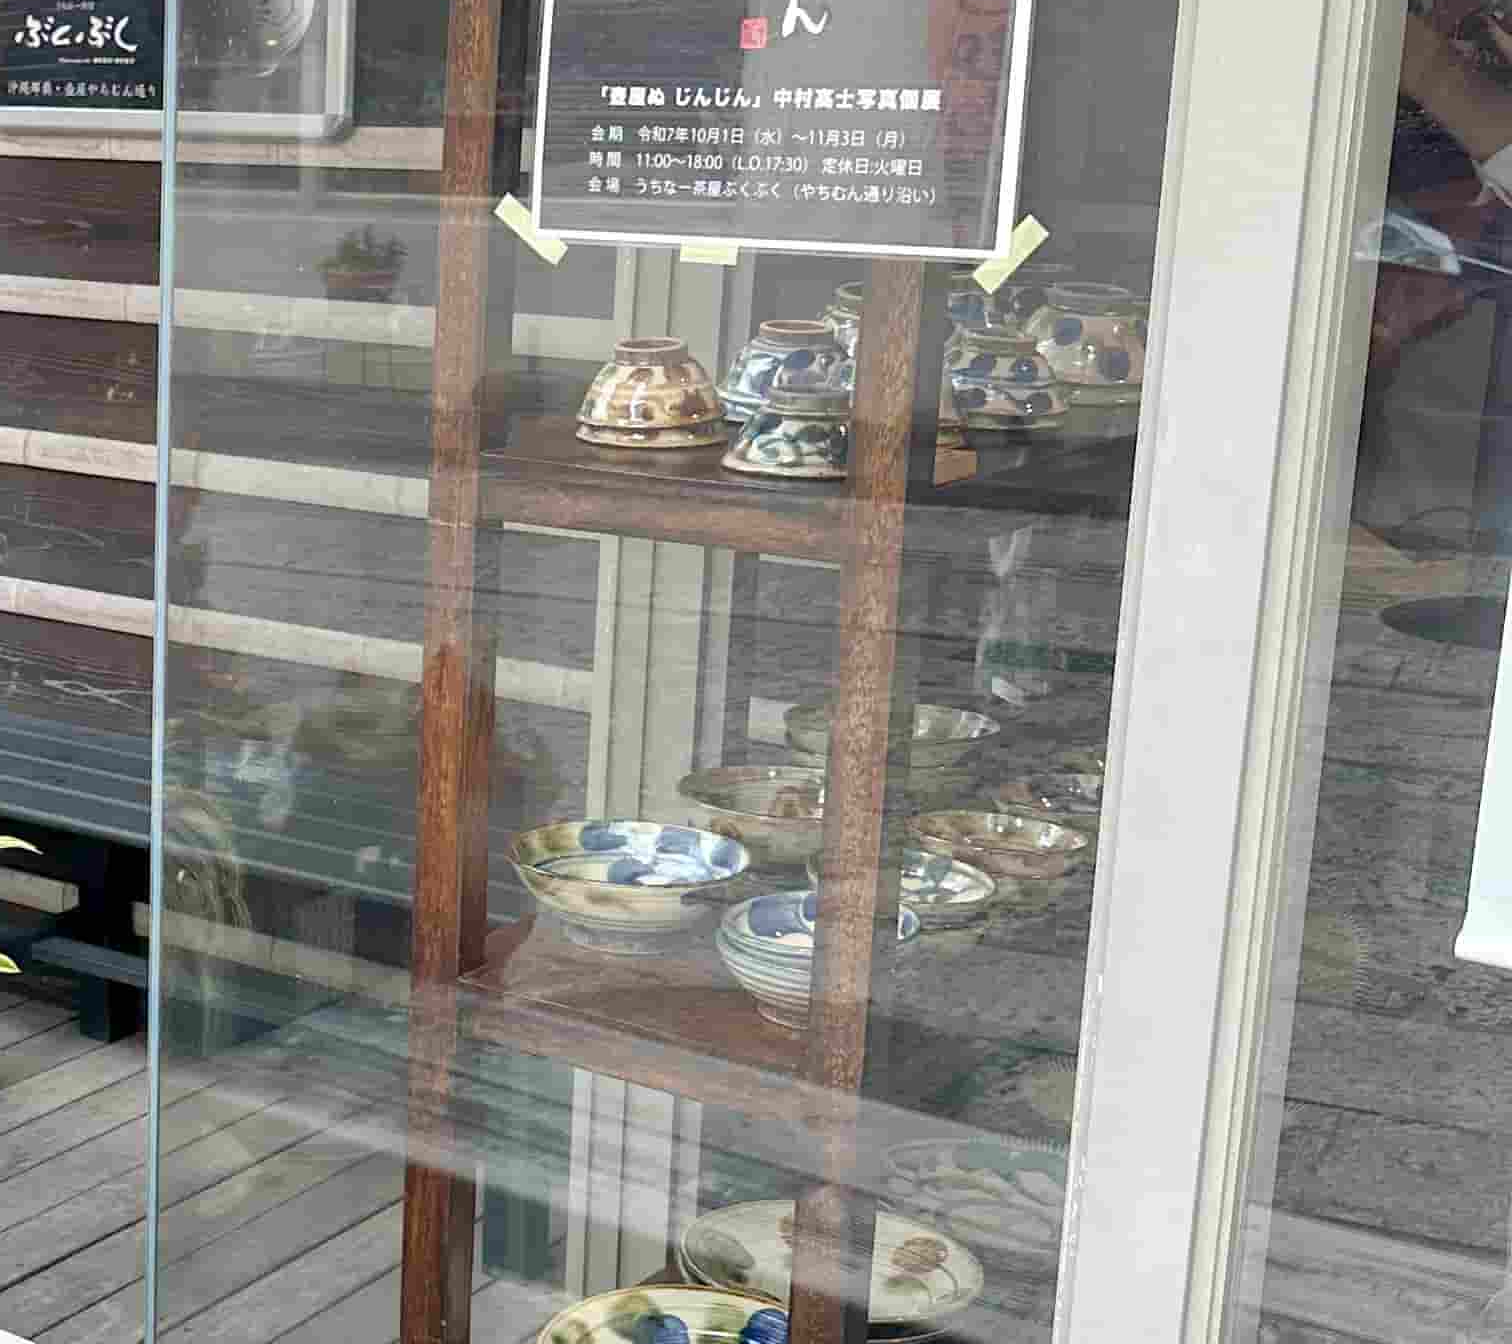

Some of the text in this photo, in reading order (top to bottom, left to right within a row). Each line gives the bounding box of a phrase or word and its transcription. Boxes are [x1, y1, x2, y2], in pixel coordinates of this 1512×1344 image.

[591, 124, 624, 143] 会期
[588, 150, 622, 169] 時間
[588, 175, 621, 195] 会場
